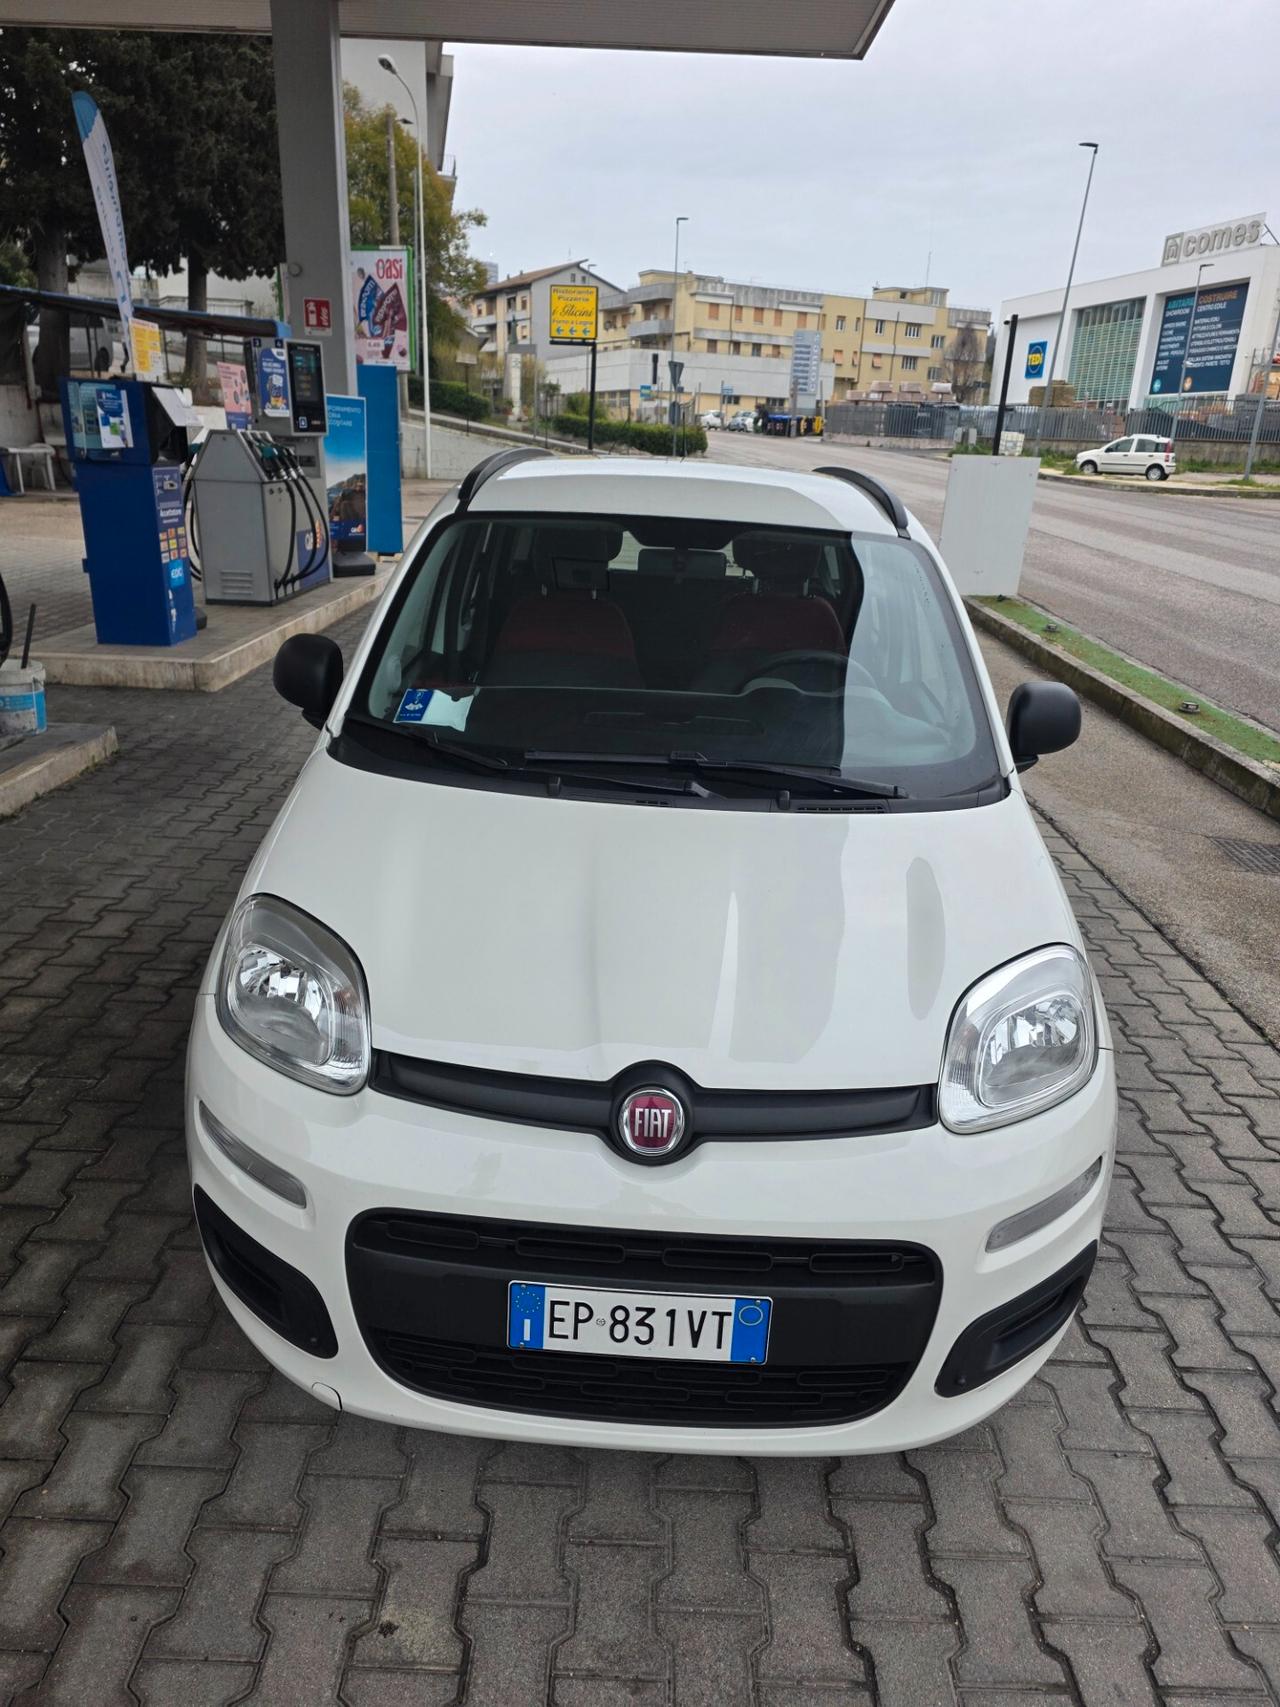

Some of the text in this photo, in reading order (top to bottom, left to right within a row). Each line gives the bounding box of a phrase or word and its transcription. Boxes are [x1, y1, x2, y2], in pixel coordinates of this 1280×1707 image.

[1182, 220, 1261, 257] comes
[1199, 290, 1238, 303] COSTRUIRE
[634, 1107, 672, 1138] FIAT
[548, 1299, 595, 1340] EP
[609, 1305, 733, 1349] 831VT
